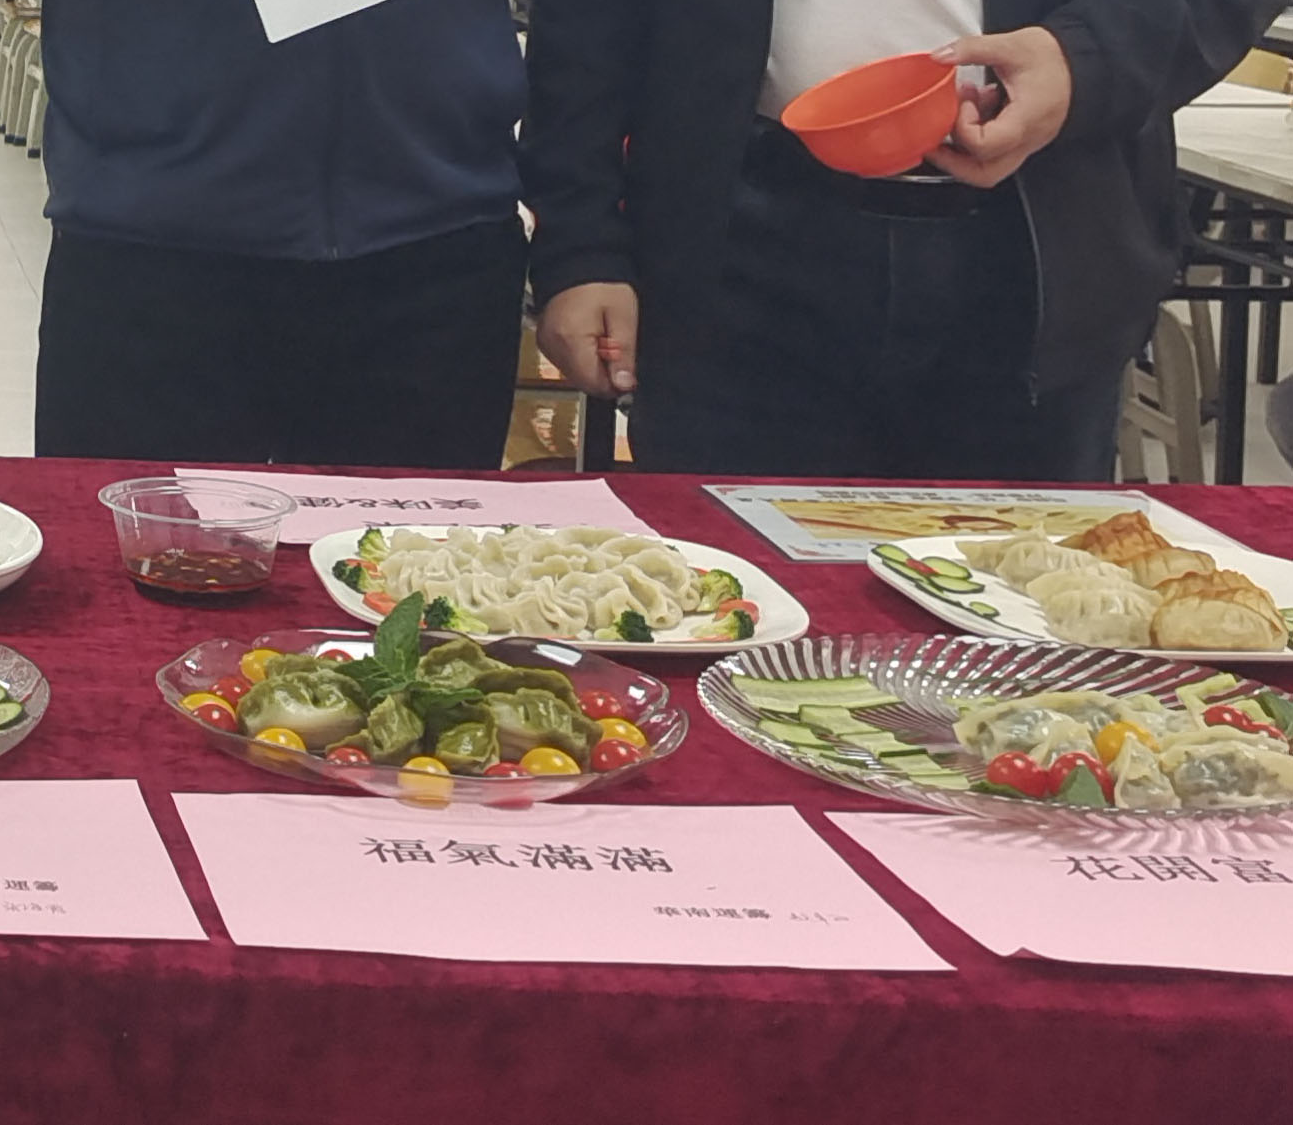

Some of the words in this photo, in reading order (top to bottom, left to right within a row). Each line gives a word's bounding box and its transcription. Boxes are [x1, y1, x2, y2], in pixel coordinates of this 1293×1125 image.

[358, 835, 675, 875] 福氣滿滿
[1049, 853, 1293, 885] 花開富
